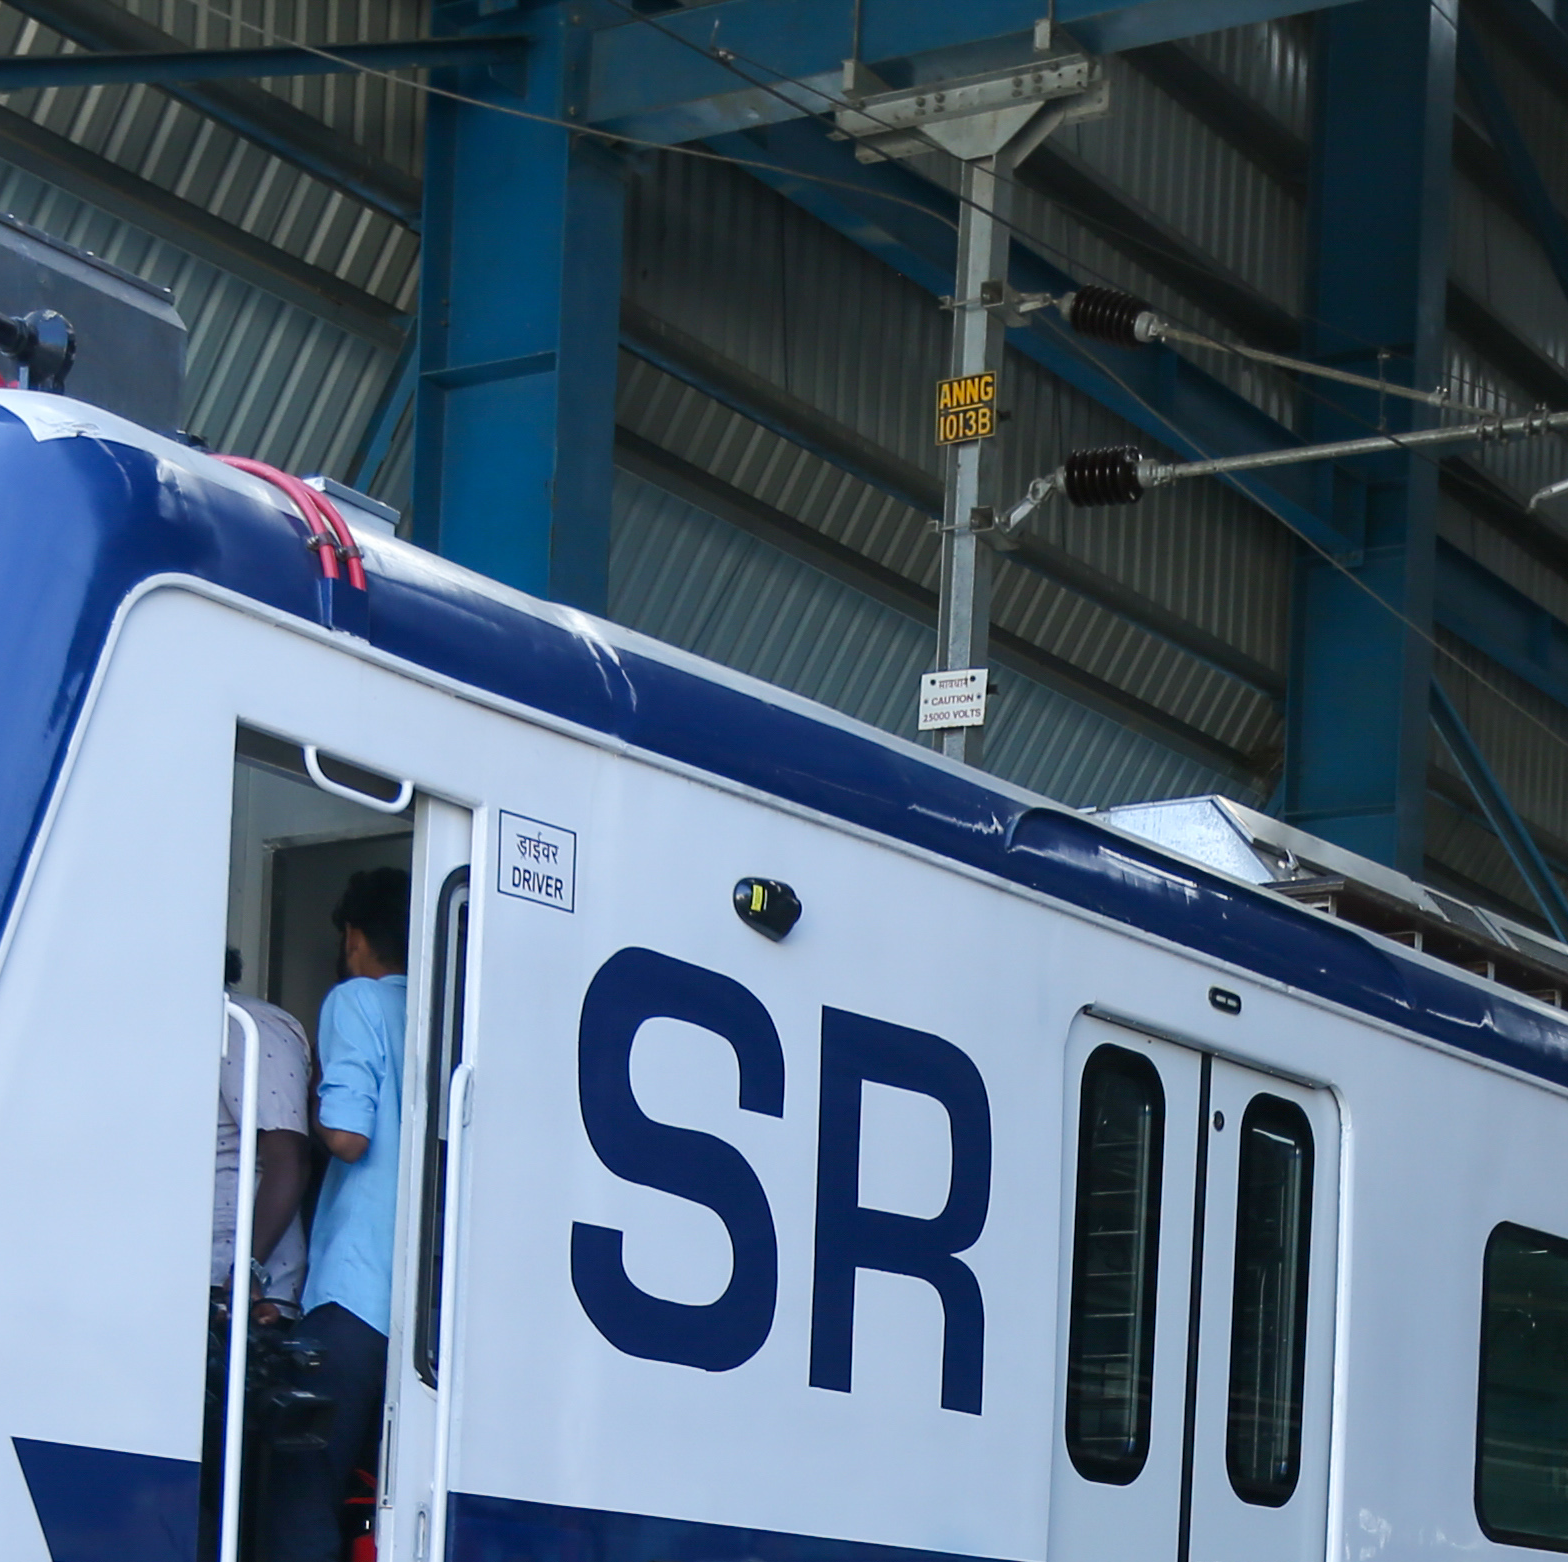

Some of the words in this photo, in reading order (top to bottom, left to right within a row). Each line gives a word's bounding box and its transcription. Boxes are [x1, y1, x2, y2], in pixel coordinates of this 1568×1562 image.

[939, 375, 994, 409] ANNG
[939, 407, 991, 441] 1013B
[923, 711, 951, 723] 25000
[953, 708, 981, 719] VOLTS
[931, 693, 974, 706] CAUTION
[512, 865, 563, 900] DRIVER
[571, 946, 993, 1416] SR
